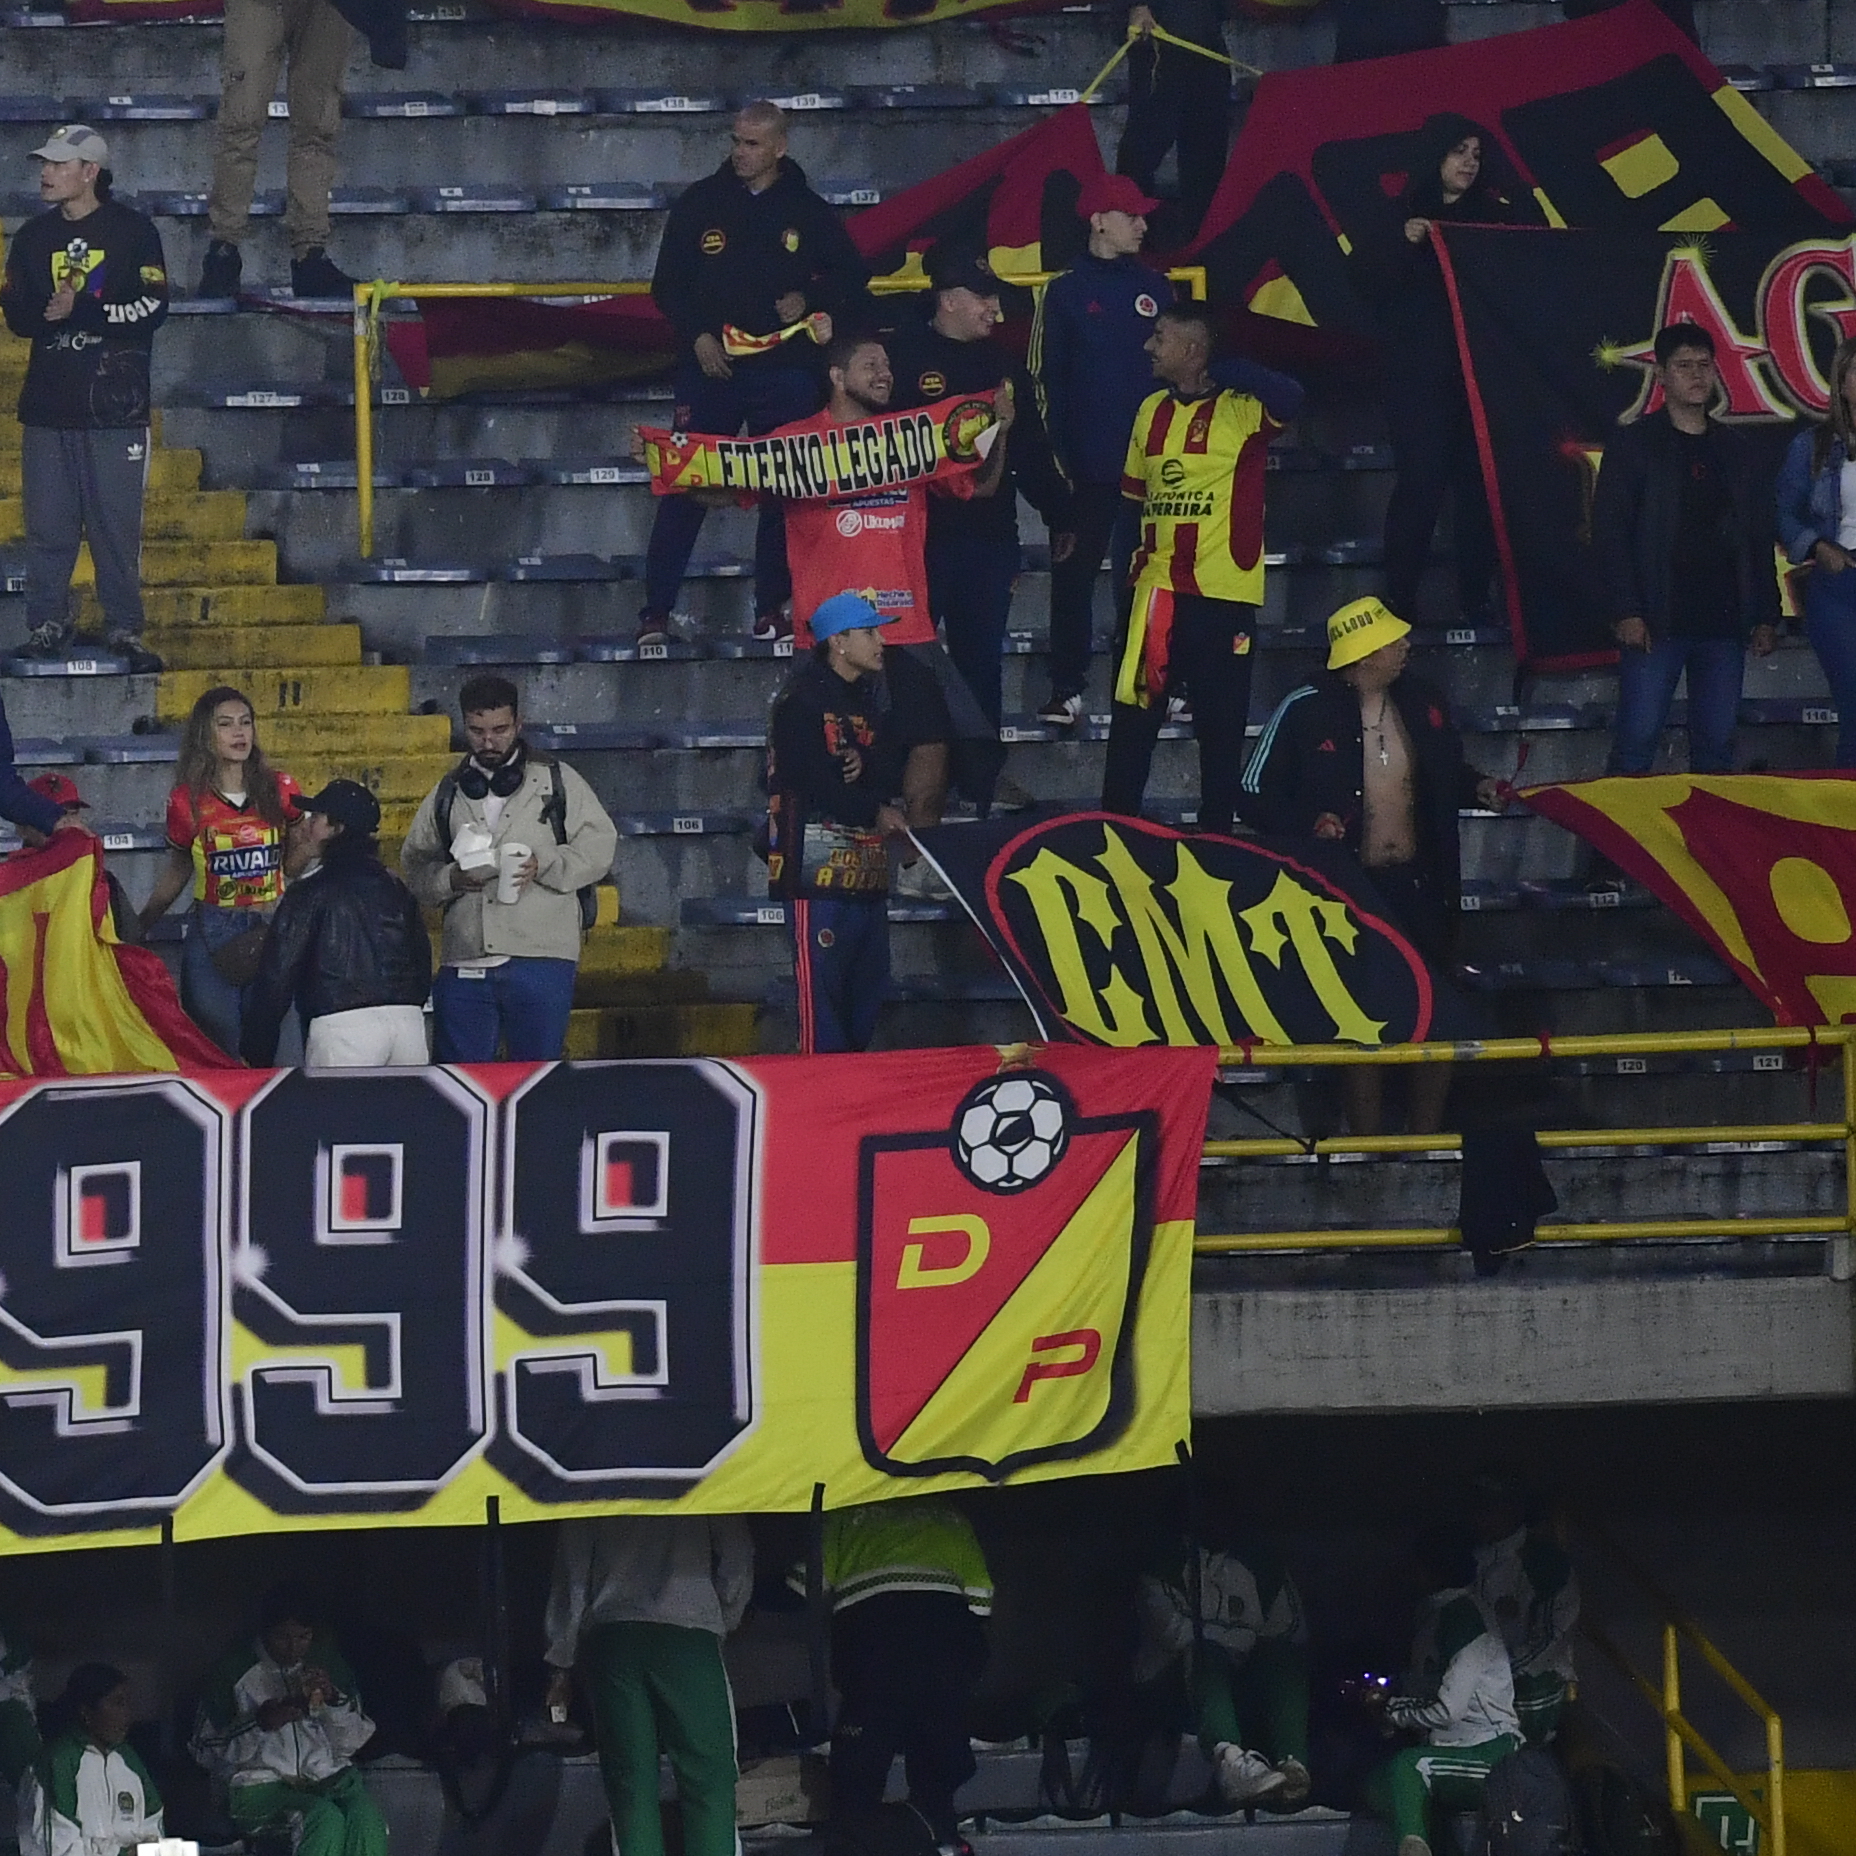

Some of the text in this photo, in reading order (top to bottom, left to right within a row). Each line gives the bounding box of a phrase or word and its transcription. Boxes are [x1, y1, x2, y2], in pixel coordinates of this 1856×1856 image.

[384, 391, 406, 402] 128
[717, 411, 939, 498] ETERNO LEGADO
[469, 471, 491, 482] 128
[1448, 630, 1472, 641] 116
[642, 646, 663, 657] 110
[1805, 710, 1829, 722] 116
[677, 819, 700, 830] 106
[107, 836, 129, 846] 104
[761, 908, 783, 921] 106
[1005, 822, 1388, 1045] CMT
[1620, 1060, 1643, 1071] 120
[1757, 1057, 1780, 1068] 121
[895, 1213, 992, 1290] D
[1012, 1328, 1102, 1404] P
